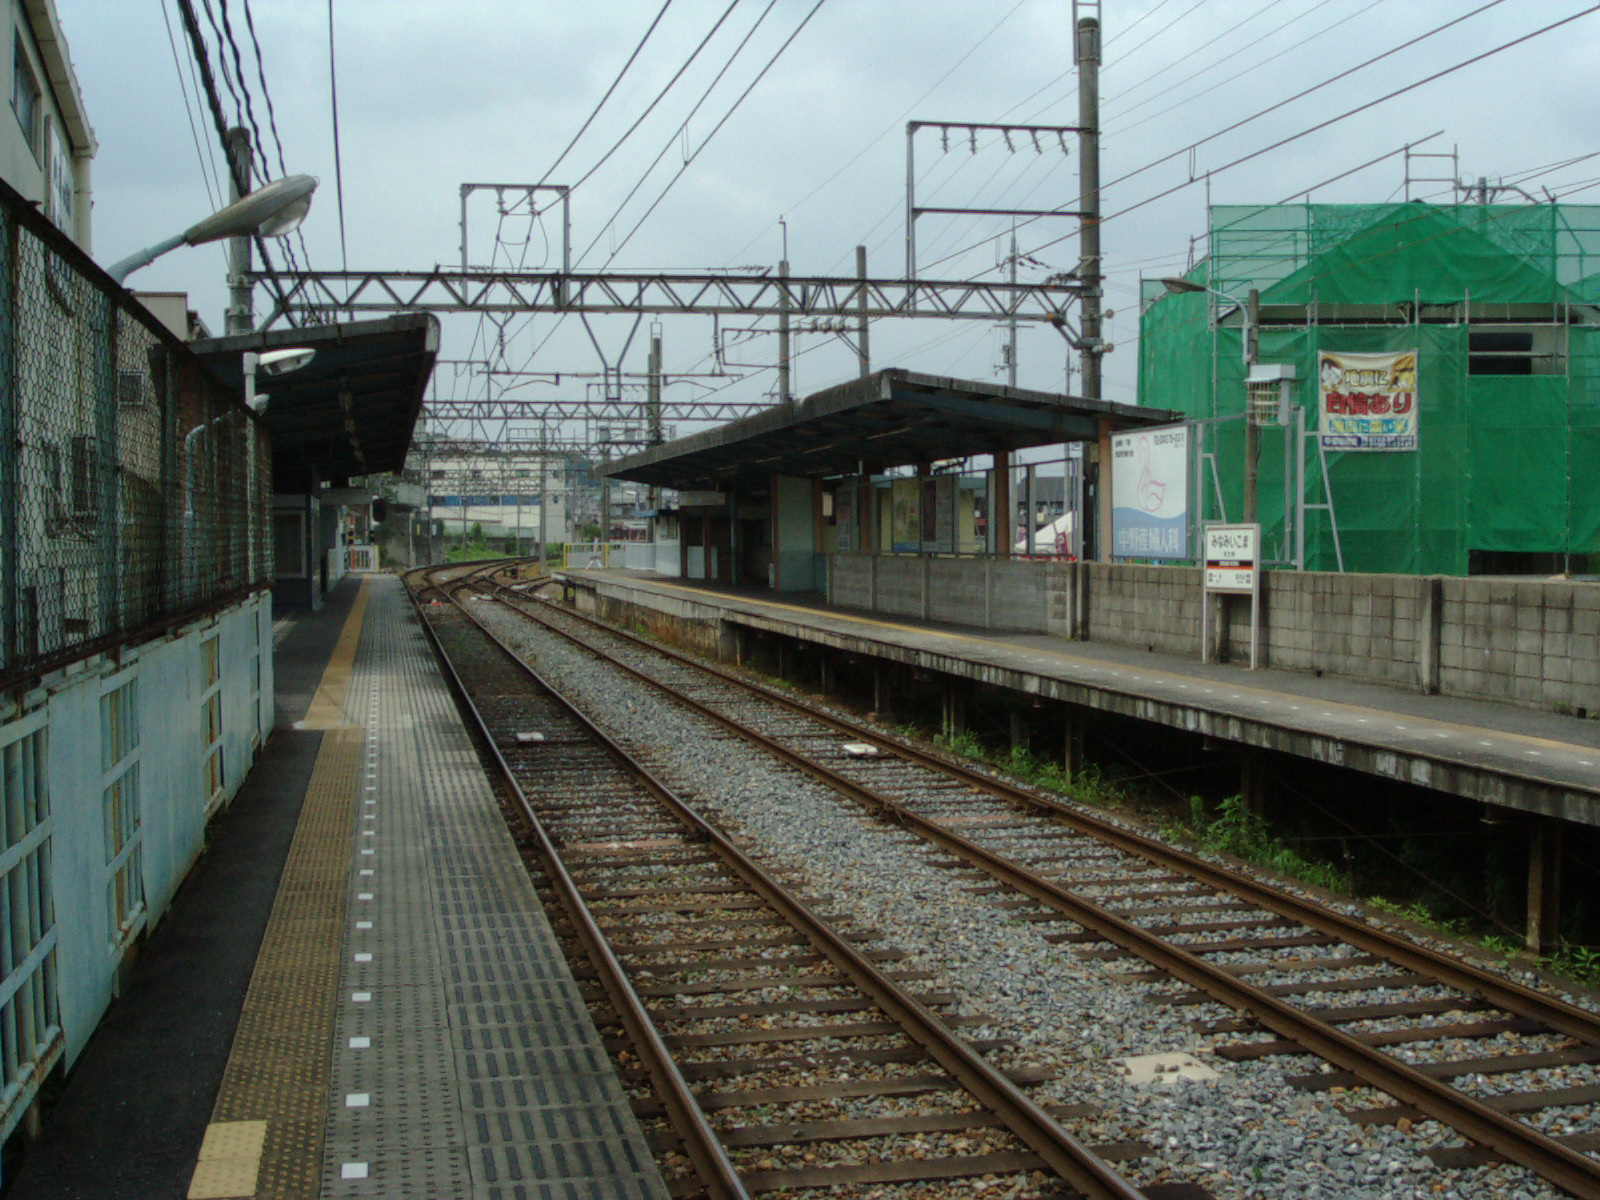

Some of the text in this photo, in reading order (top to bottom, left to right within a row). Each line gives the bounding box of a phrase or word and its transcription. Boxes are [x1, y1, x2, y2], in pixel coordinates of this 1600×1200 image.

[1326, 391, 1412, 415] 自信あり
[1118, 527, 1179, 553] 中野産婦人科
[1211, 534, 1249, 549] みなみいこま
